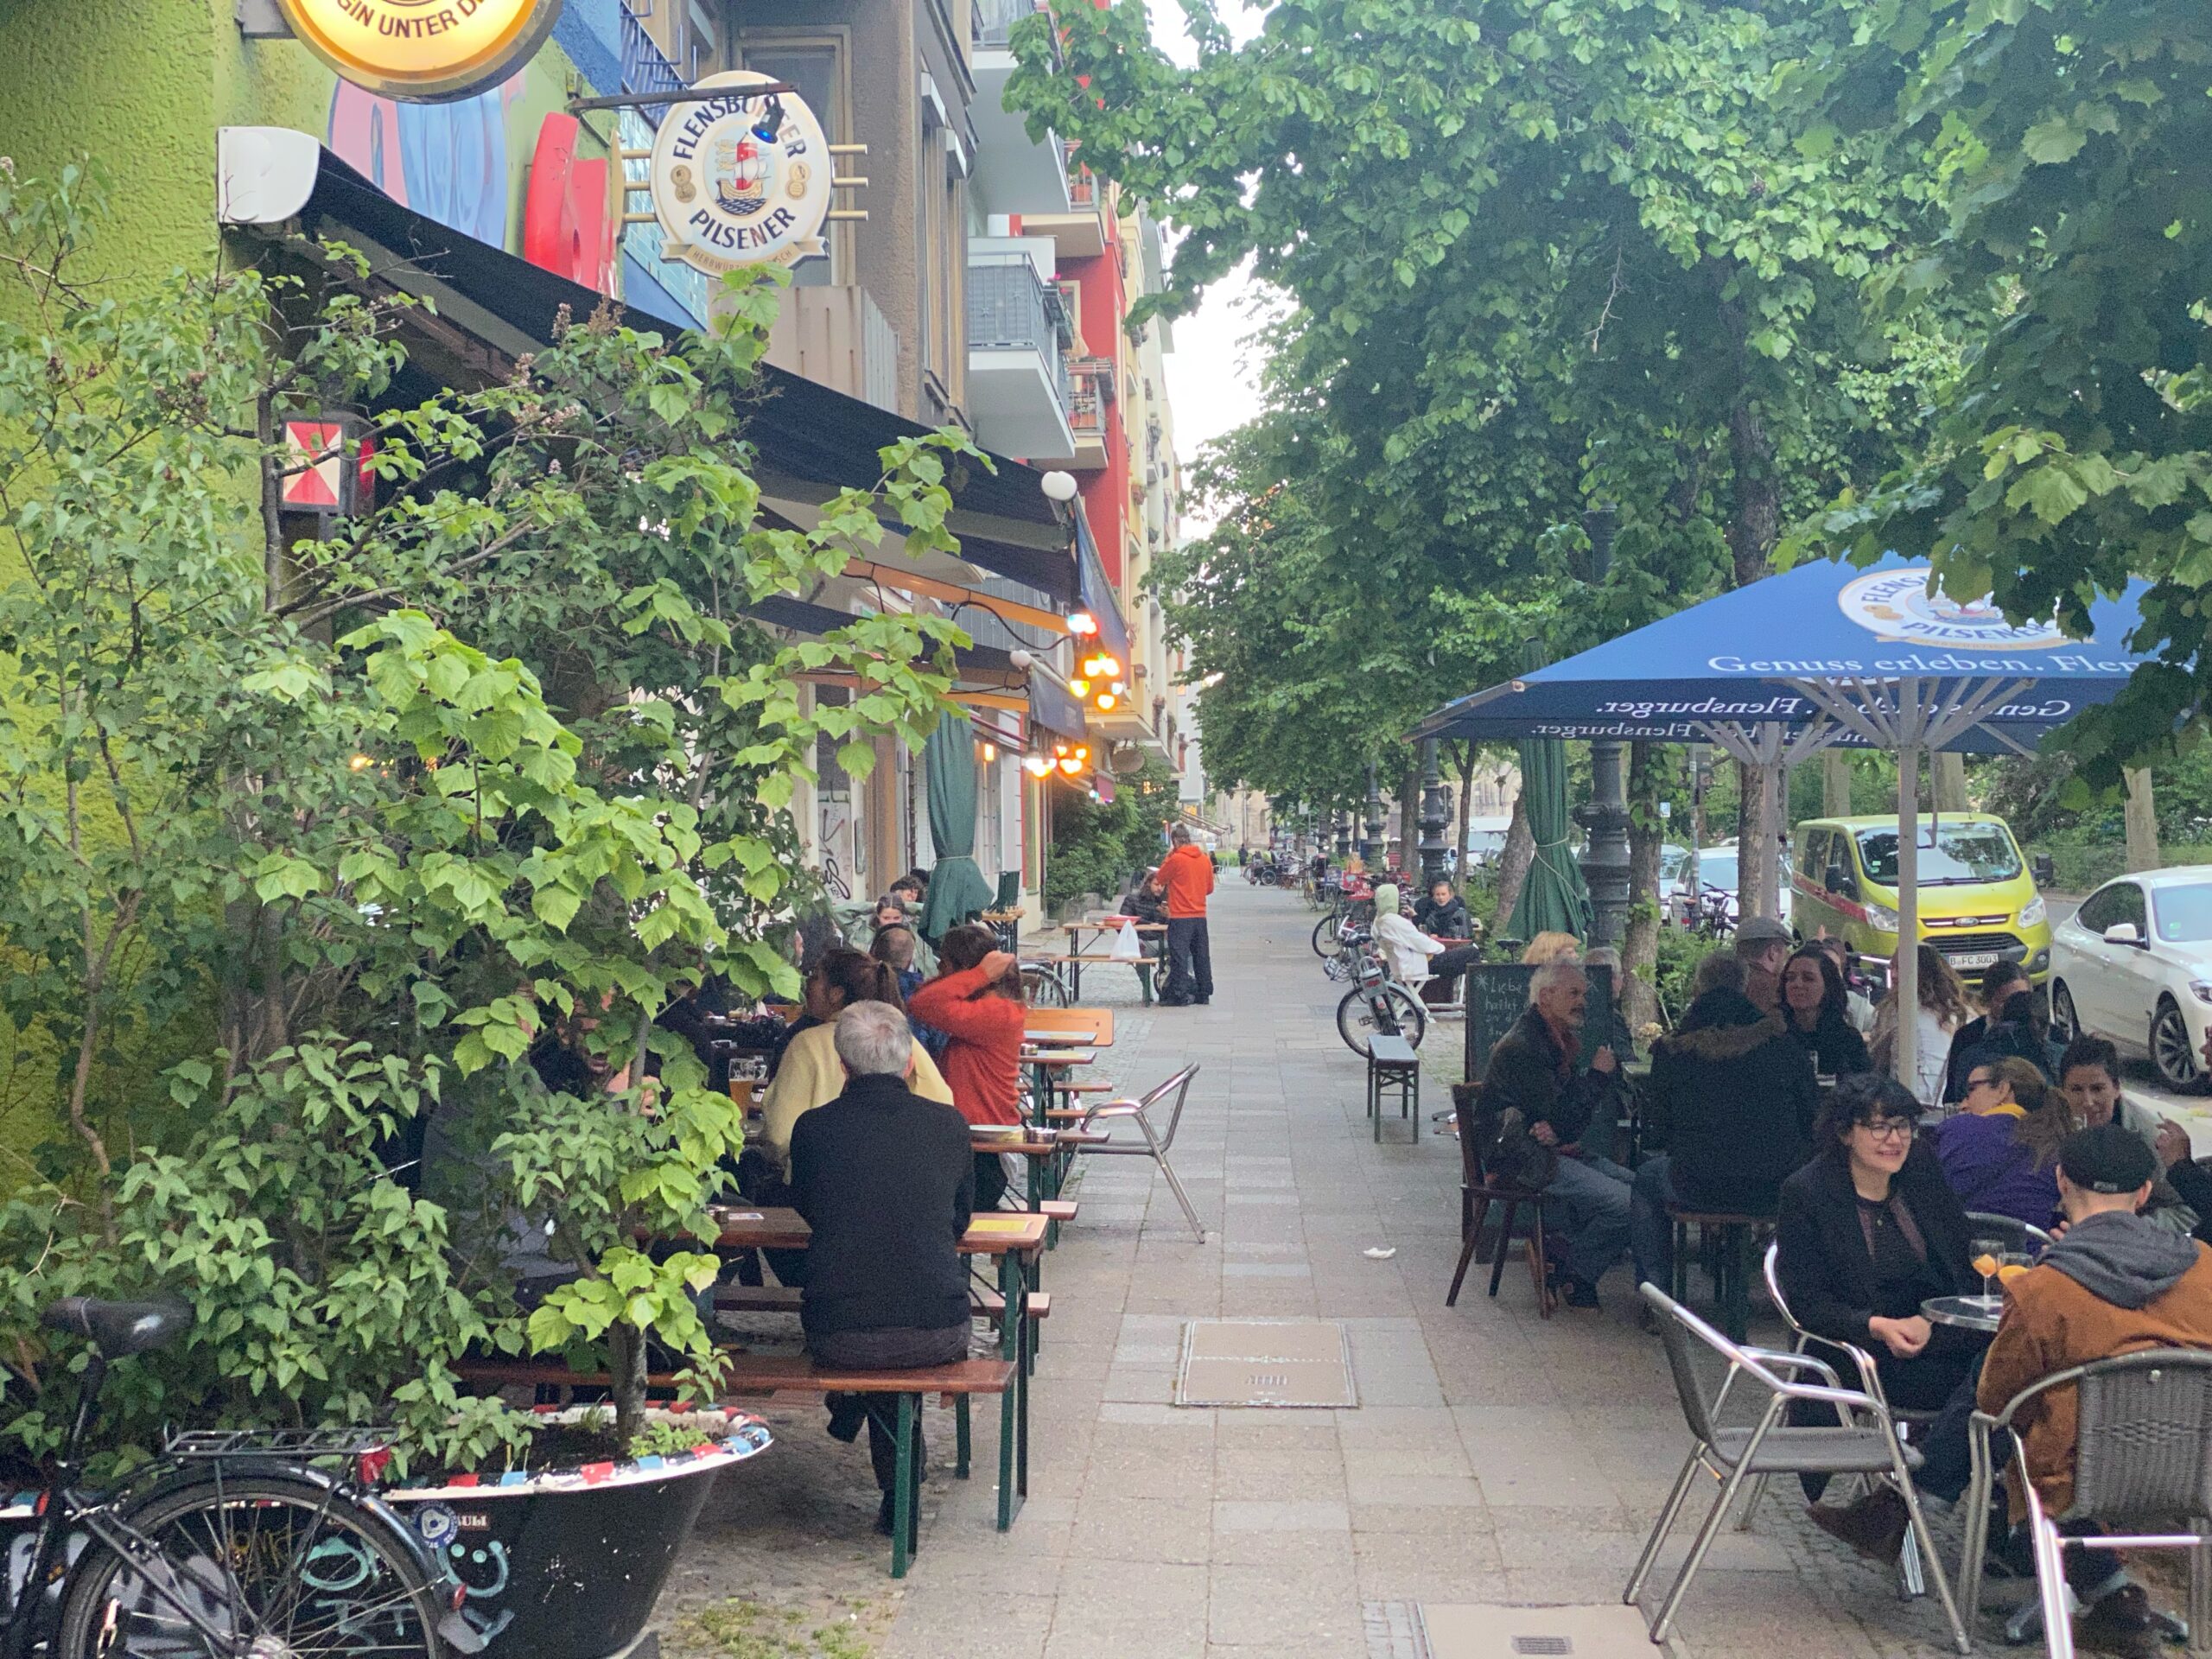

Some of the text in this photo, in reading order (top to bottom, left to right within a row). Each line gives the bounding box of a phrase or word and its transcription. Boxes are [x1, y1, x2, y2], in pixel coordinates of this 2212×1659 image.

[378, 9, 459, 38] UNTER
[689, 207, 797, 250] PILSENER
[1707, 656, 1863, 672] Genuss
[1874, 653, 2044, 672] erleben.
